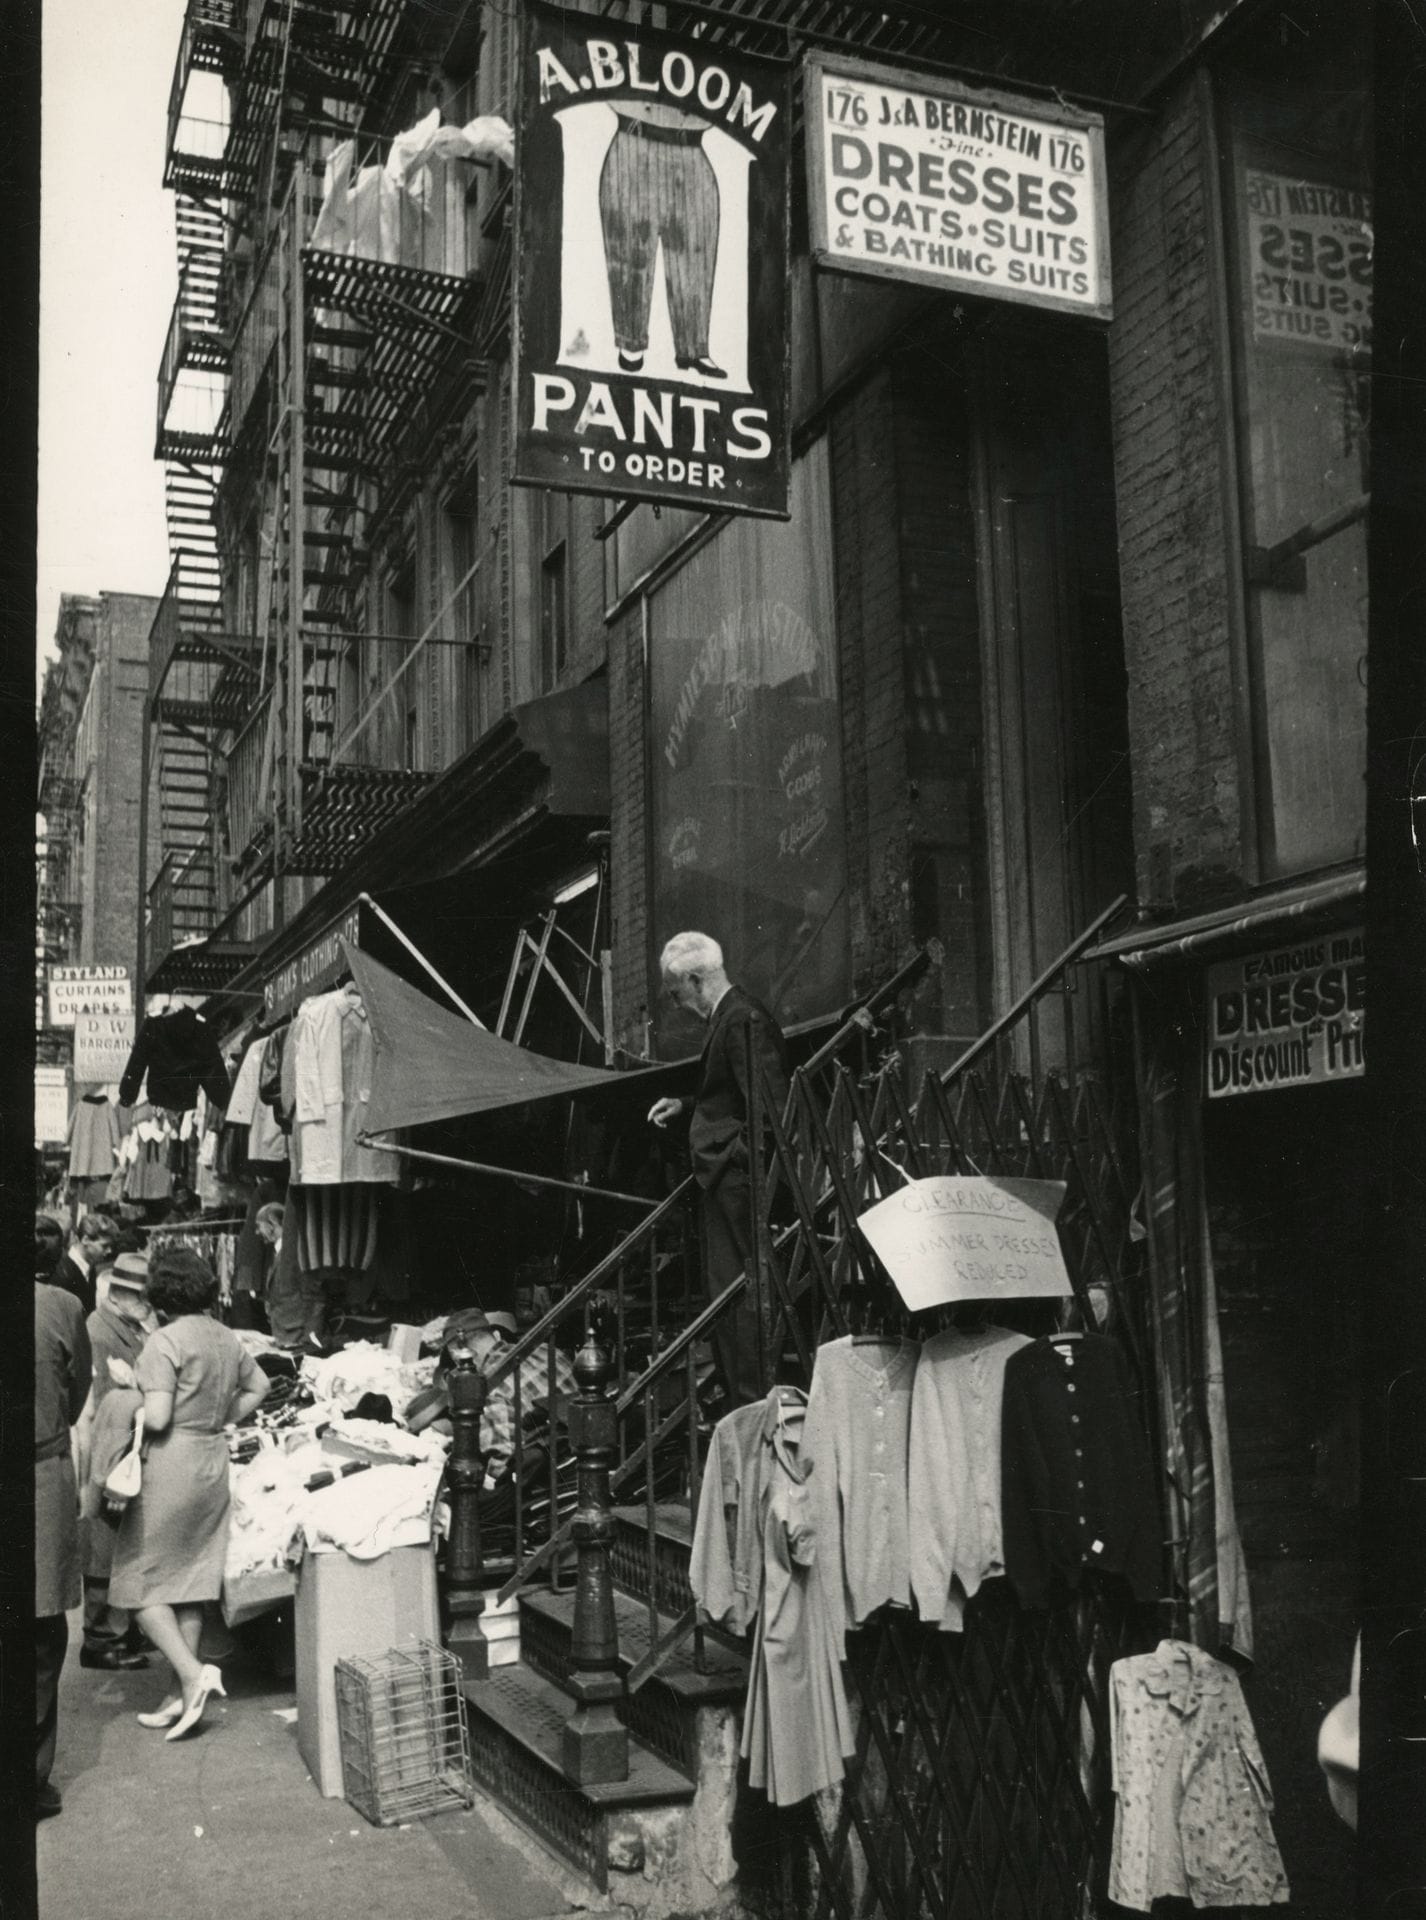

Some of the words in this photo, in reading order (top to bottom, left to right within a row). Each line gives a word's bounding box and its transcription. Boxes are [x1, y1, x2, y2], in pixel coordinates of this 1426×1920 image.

[827, 89, 869, 126] 176
[925, 100, 1042, 161] BERNSTEIN
[1049, 137, 1085, 172] 176
[831, 133, 1078, 226] DRESSES
[835, 224, 854, 249] &
[863, 228, 997, 276] BATHING
[1007, 259, 1089, 295] SUITS
[531, 373, 772, 459] PANTS
[579, 446, 616, 473] TO
[625, 454, 726, 489] ORDER
[53, 965, 127, 980] STYLAND
[55, 984, 125, 997] CURTAINS
[58, 1002, 120, 1015] DRAPES
[902, 1190, 1021, 1213] CLEARANCE
[954, 1259, 1028, 1281] REDUCED
